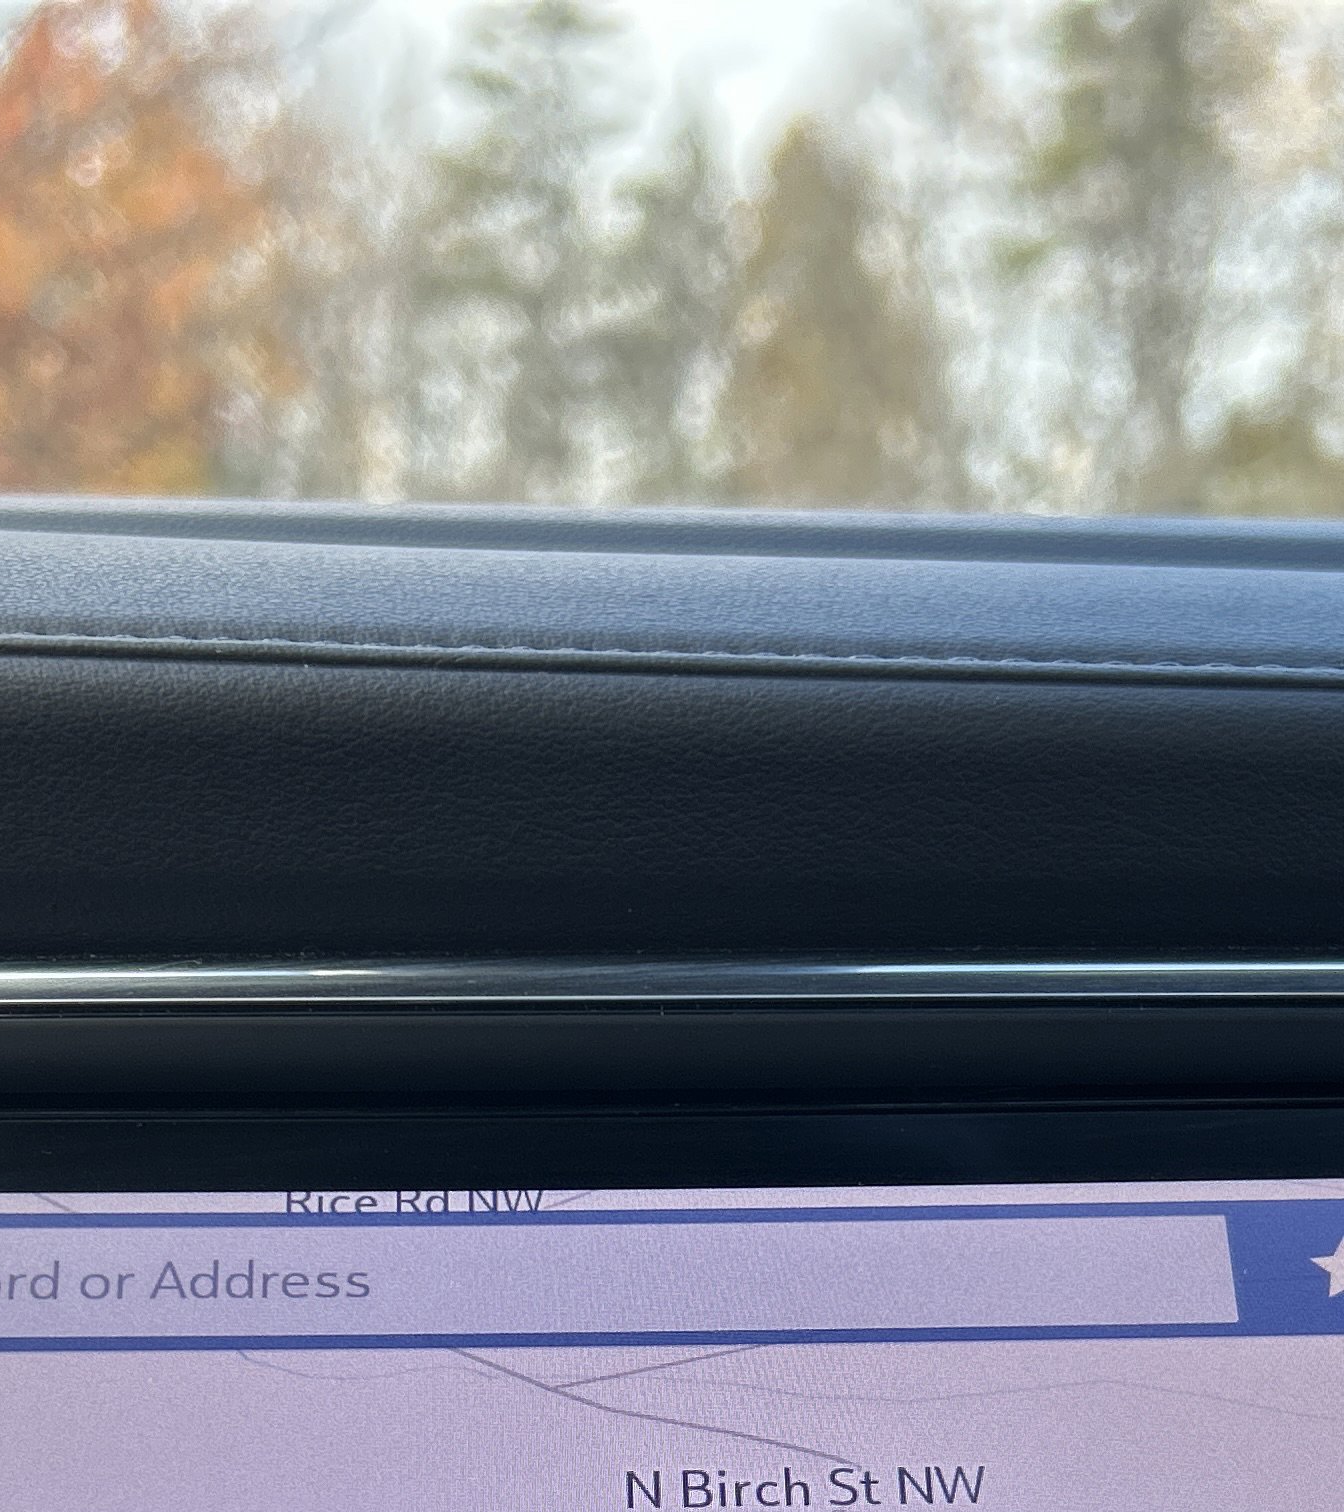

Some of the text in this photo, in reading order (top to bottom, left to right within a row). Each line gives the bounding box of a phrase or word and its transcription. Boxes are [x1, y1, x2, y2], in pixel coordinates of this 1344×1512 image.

[286, 1190, 543, 1214] Rice Rd NW
[80, 1274, 135, 1300] or
[150, 1257, 371, 1300] Address
[626, 1466, 985, 1509] N Birch St NW
